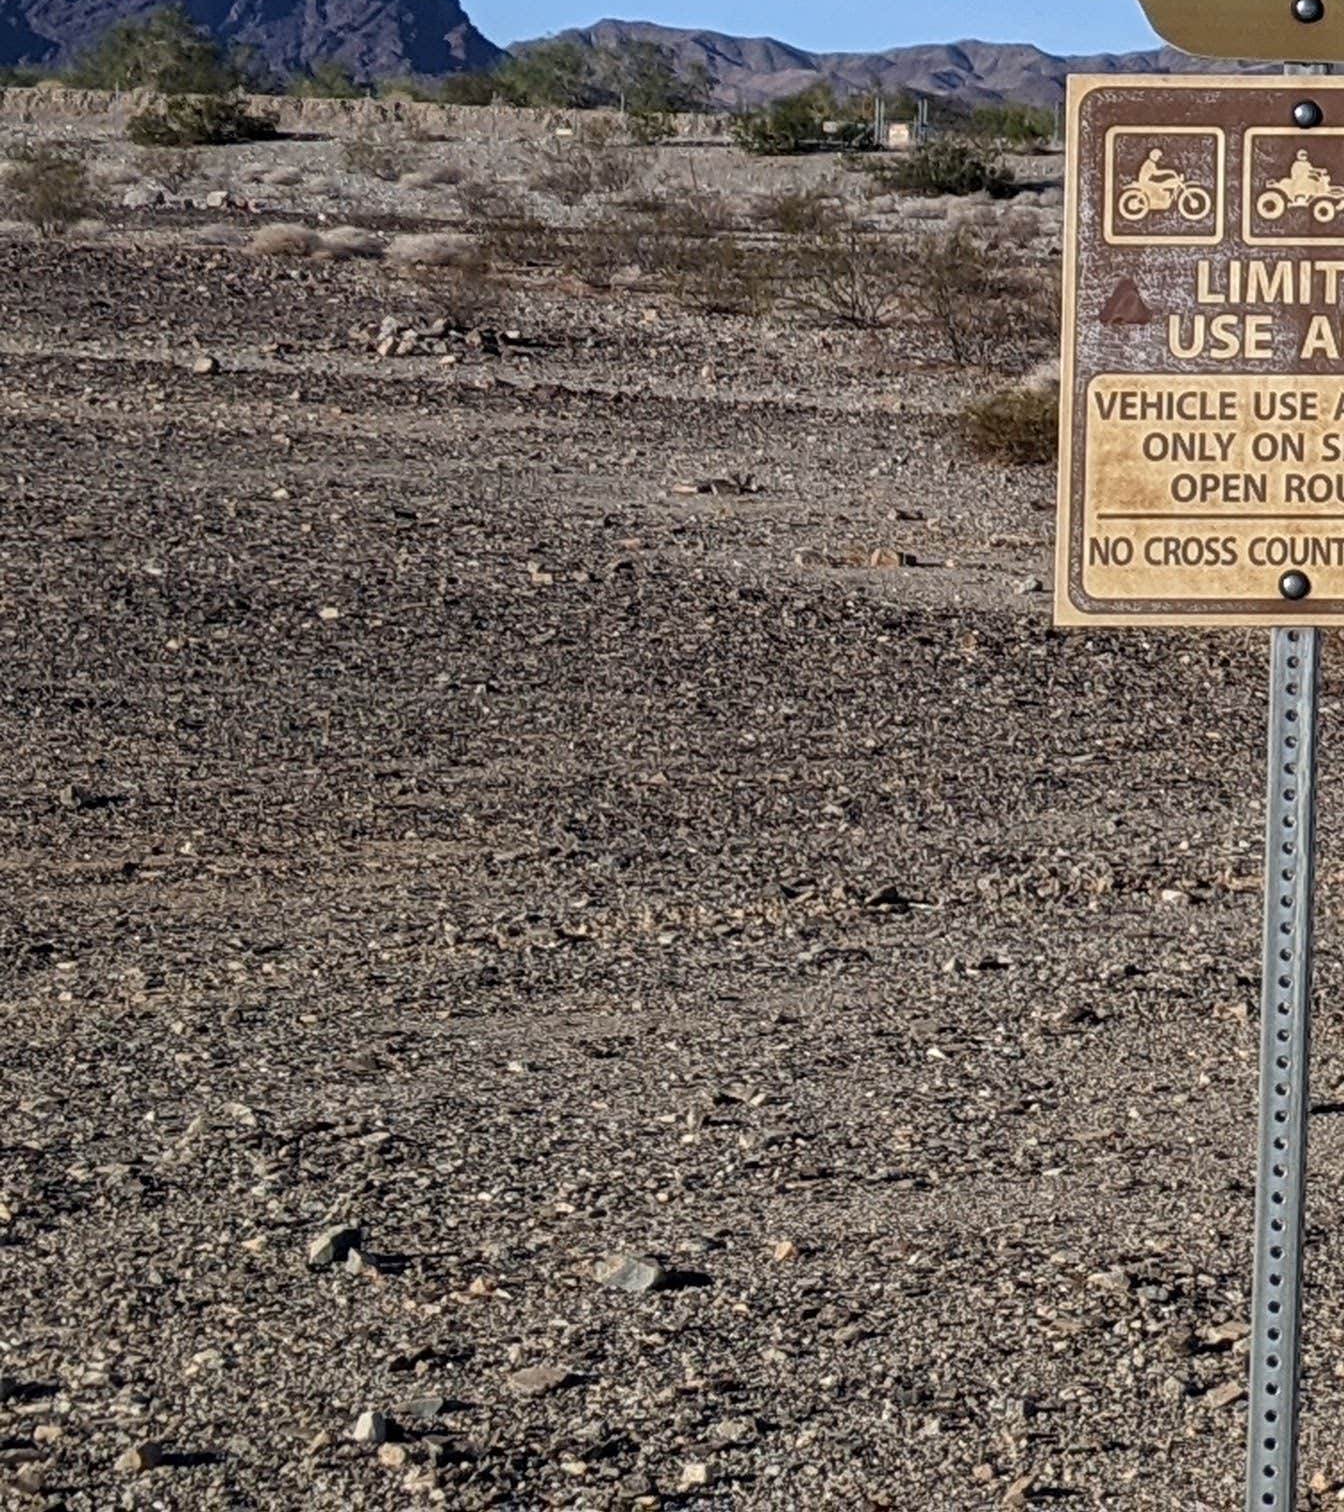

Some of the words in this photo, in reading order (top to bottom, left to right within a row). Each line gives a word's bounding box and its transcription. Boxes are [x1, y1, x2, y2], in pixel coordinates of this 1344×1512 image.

[1167, 314, 1275, 361] USE
[1094, 391, 1237, 421] VEHICLE
[1253, 391, 1318, 421] USE
[1142, 432, 1236, 462] ONLY
[1251, 432, 1304, 462] ON
[1170, 473, 1268, 503] OPEN
[1089, 537, 1134, 567] NO
[1144, 536, 1238, 567] CROSS
